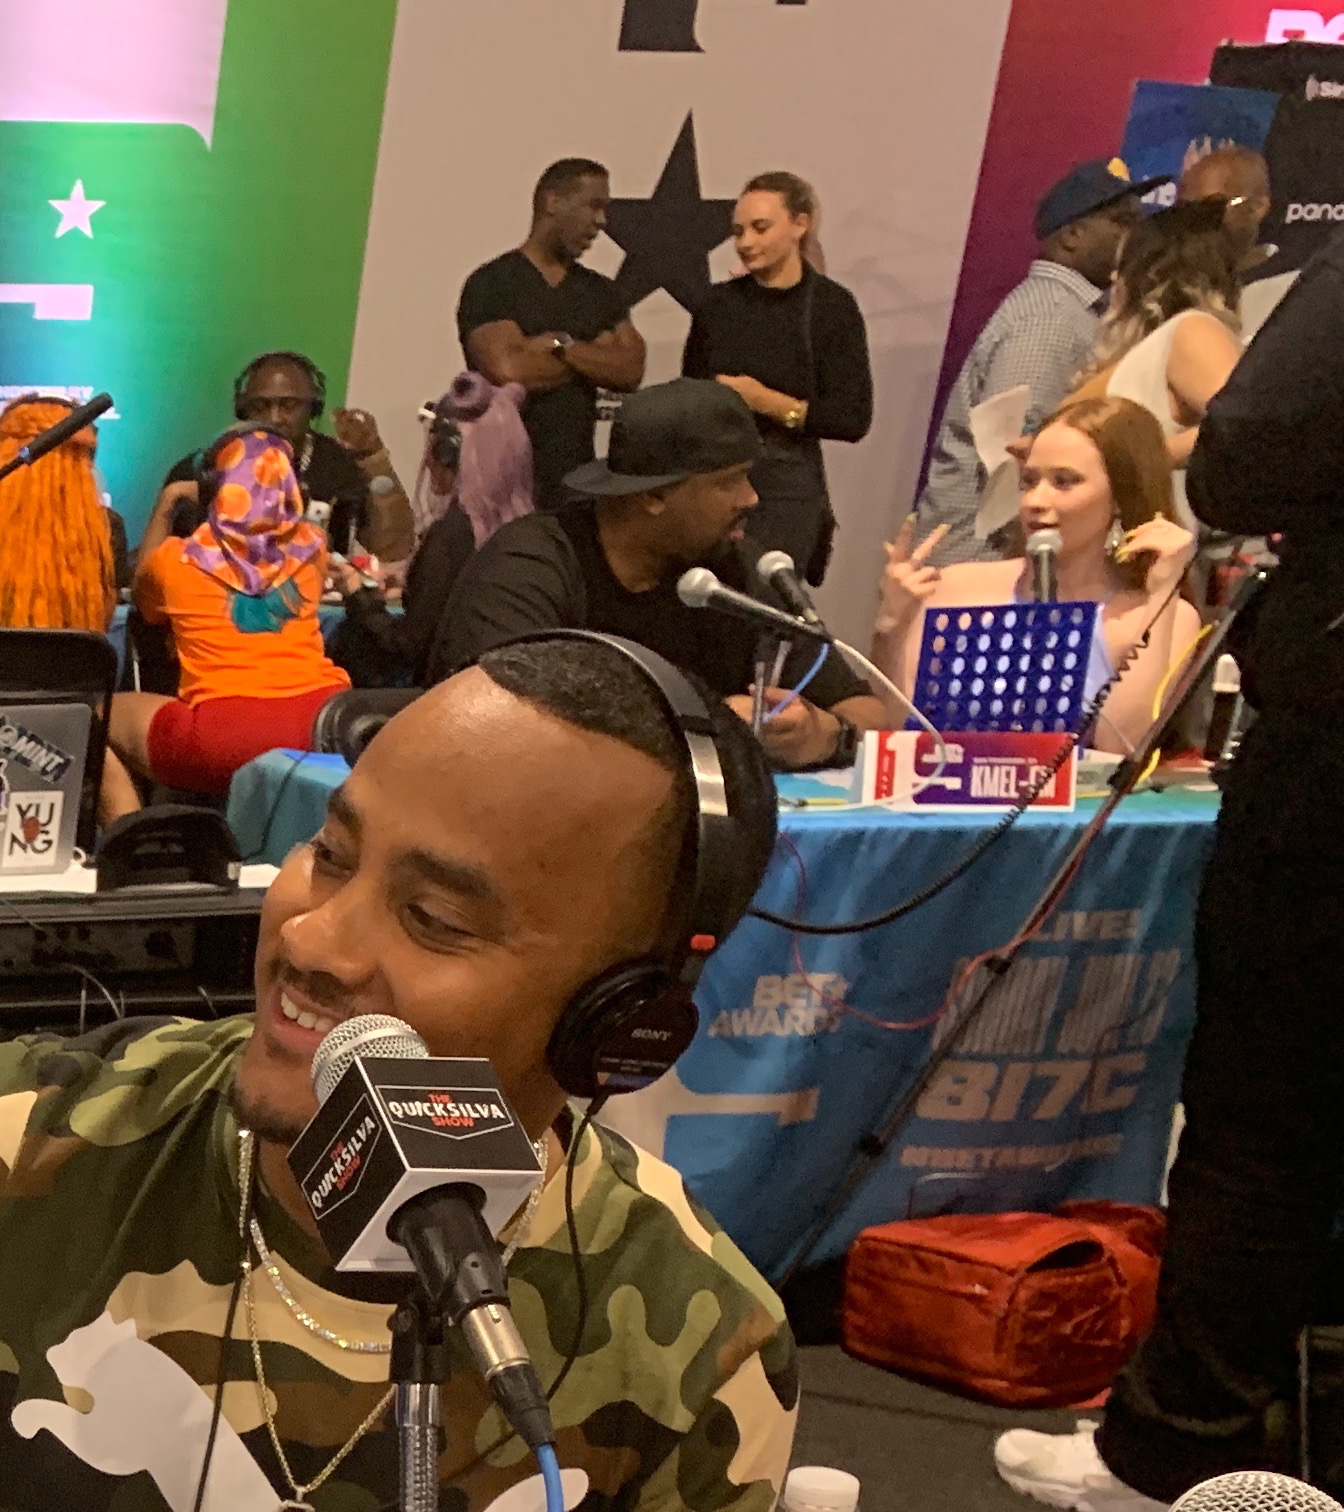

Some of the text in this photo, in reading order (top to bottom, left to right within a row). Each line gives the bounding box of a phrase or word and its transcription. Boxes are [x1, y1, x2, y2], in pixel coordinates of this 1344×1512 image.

[631, 1028, 672, 1041] SONY
[428, 1093, 452, 1103] THE
[388, 1101, 505, 1120] QUICKSILVA
[431, 1116, 475, 1127] SHOW
[311, 1115, 376, 1209] QUICKSILVA
